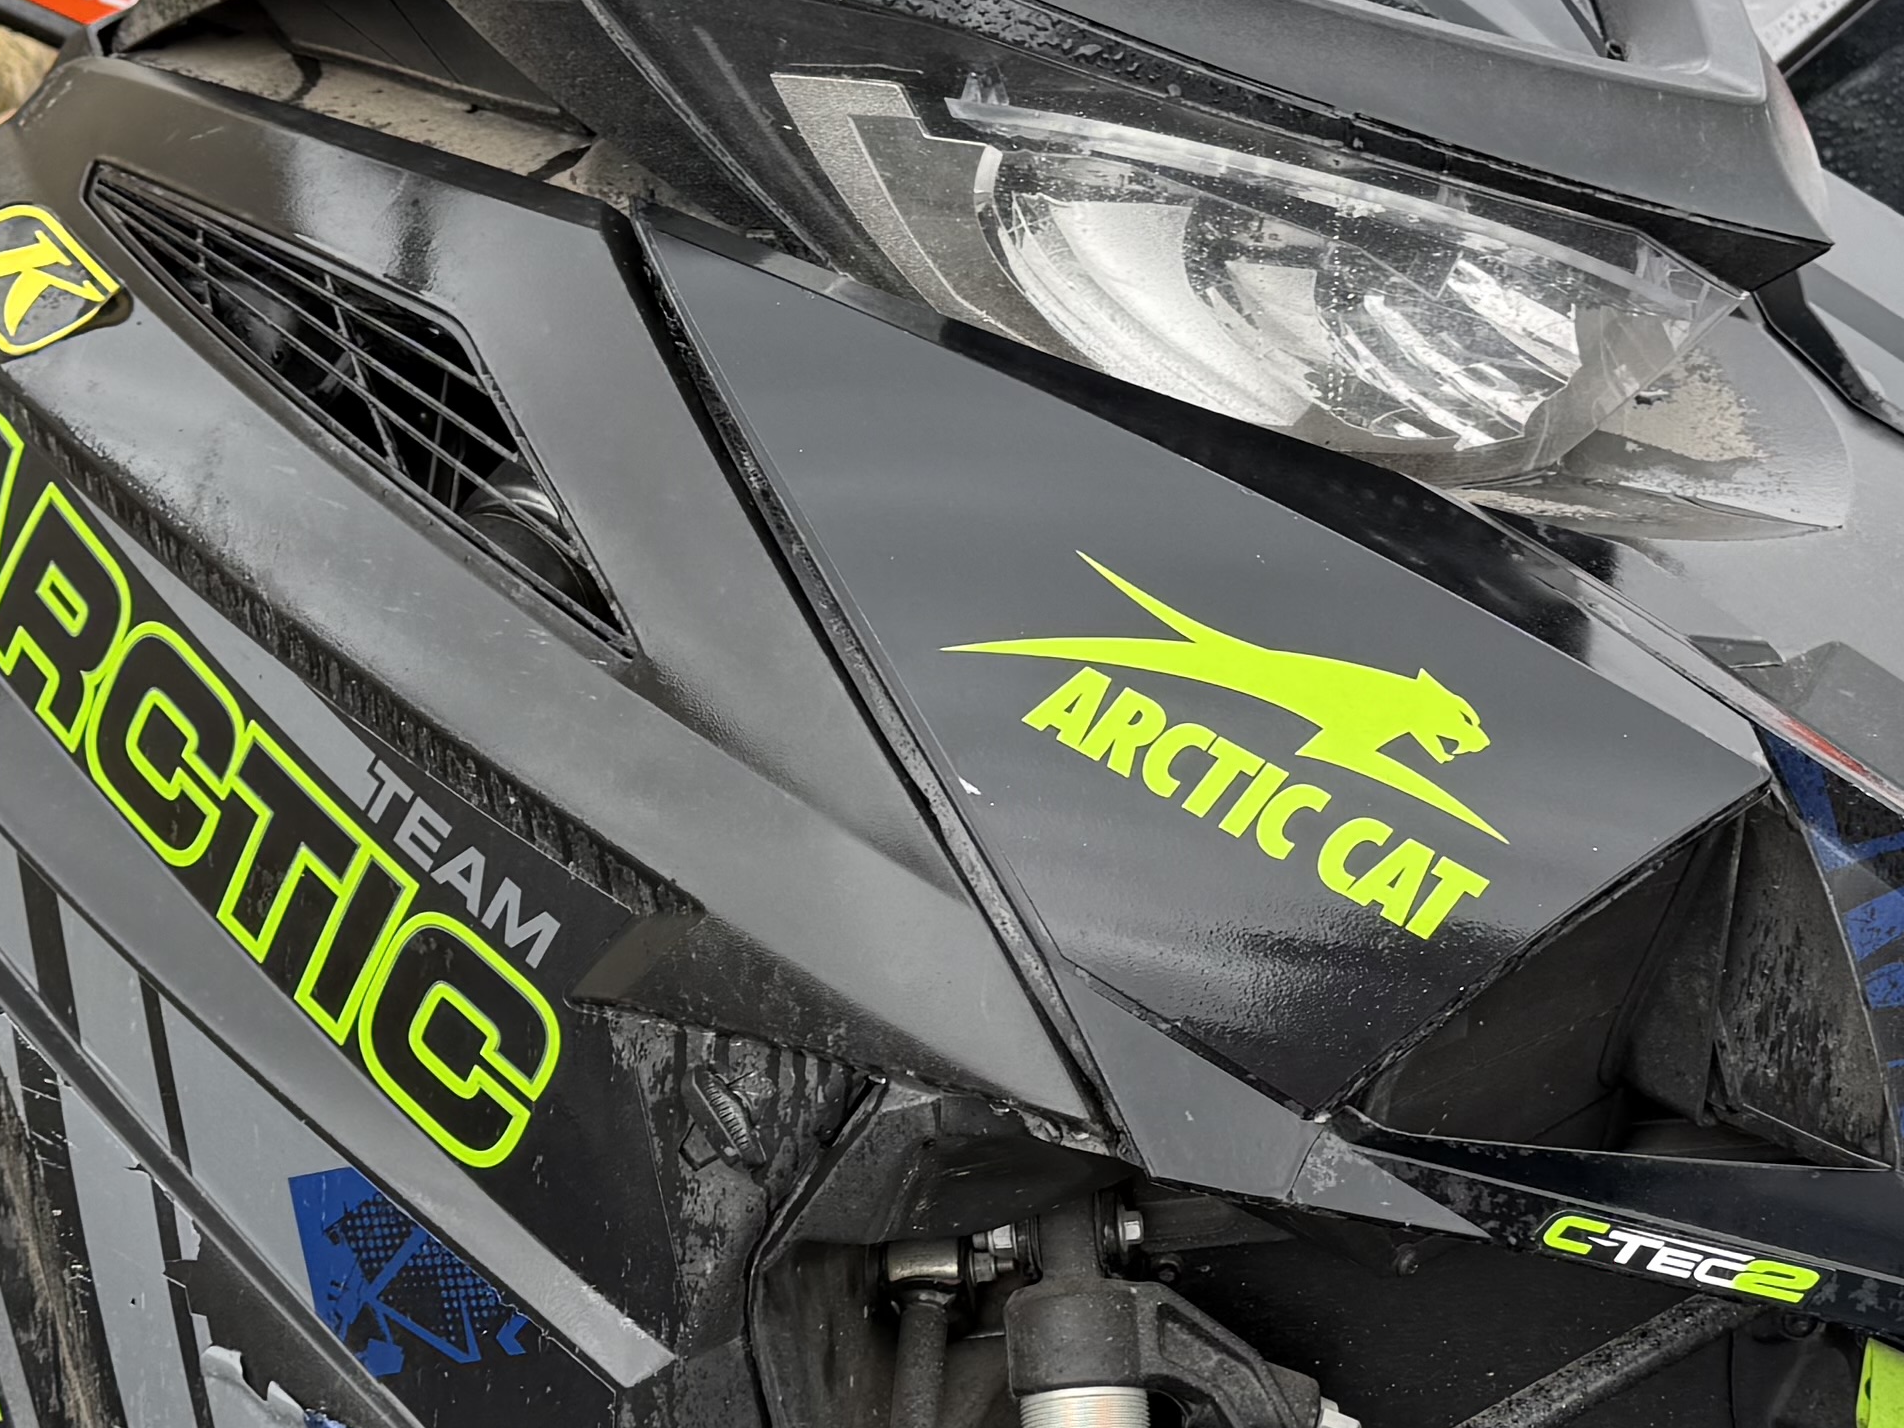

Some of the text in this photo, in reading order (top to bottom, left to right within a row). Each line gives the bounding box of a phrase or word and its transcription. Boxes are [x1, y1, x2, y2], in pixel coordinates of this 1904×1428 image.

[362, 753, 560, 967] TEAM
[1021, 666, 1491, 940] ARCTIC CAT
[1543, 1215, 1820, 1303] C-TEC2
